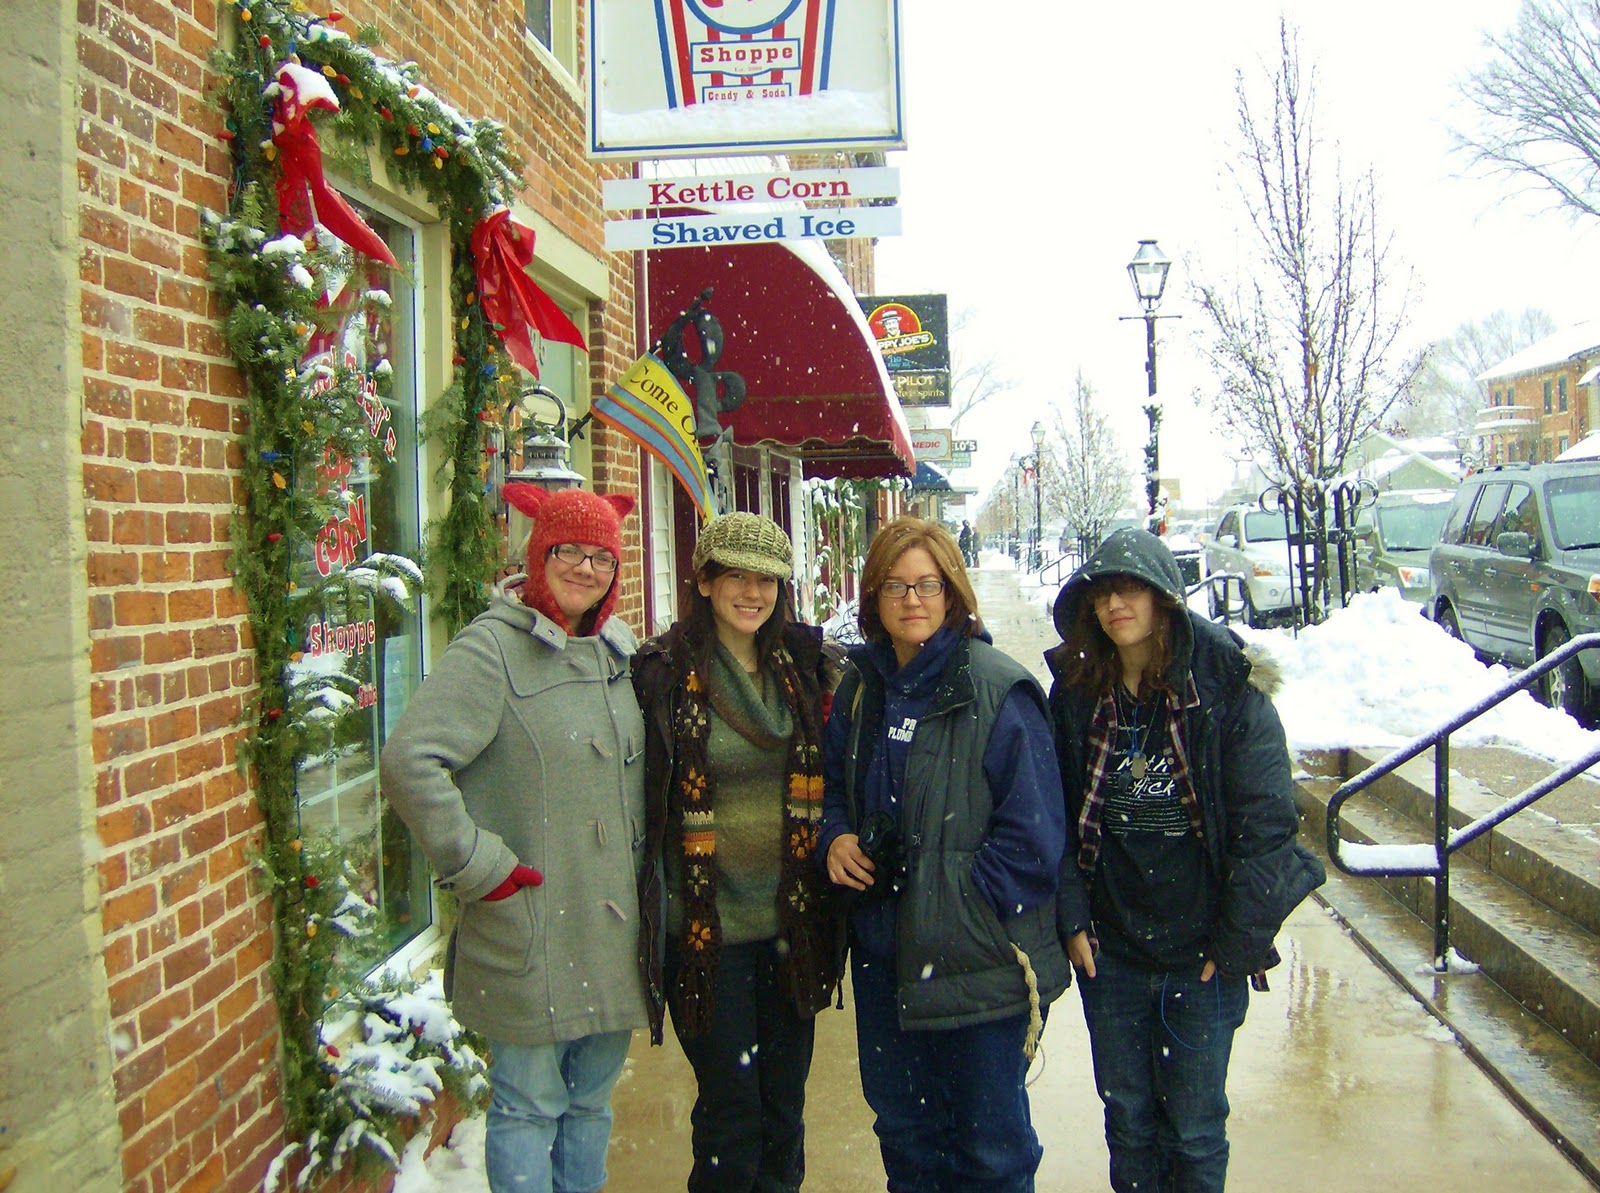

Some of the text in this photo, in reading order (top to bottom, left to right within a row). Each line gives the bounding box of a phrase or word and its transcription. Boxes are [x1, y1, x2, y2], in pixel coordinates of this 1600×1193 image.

[700, 46, 793, 64] Shoppe
[746, 89, 754, 99] &
[762, 88, 786, 98] Soda
[648, 177, 851, 205] Kettle Corn
[652, 215, 855, 245] Shaved Ice
[878, 338, 899, 350] PPY
[897, 375, 935, 388] PILOT
[315, 494, 367, 577] CORN
[310, 619, 376, 659] Shoppe
